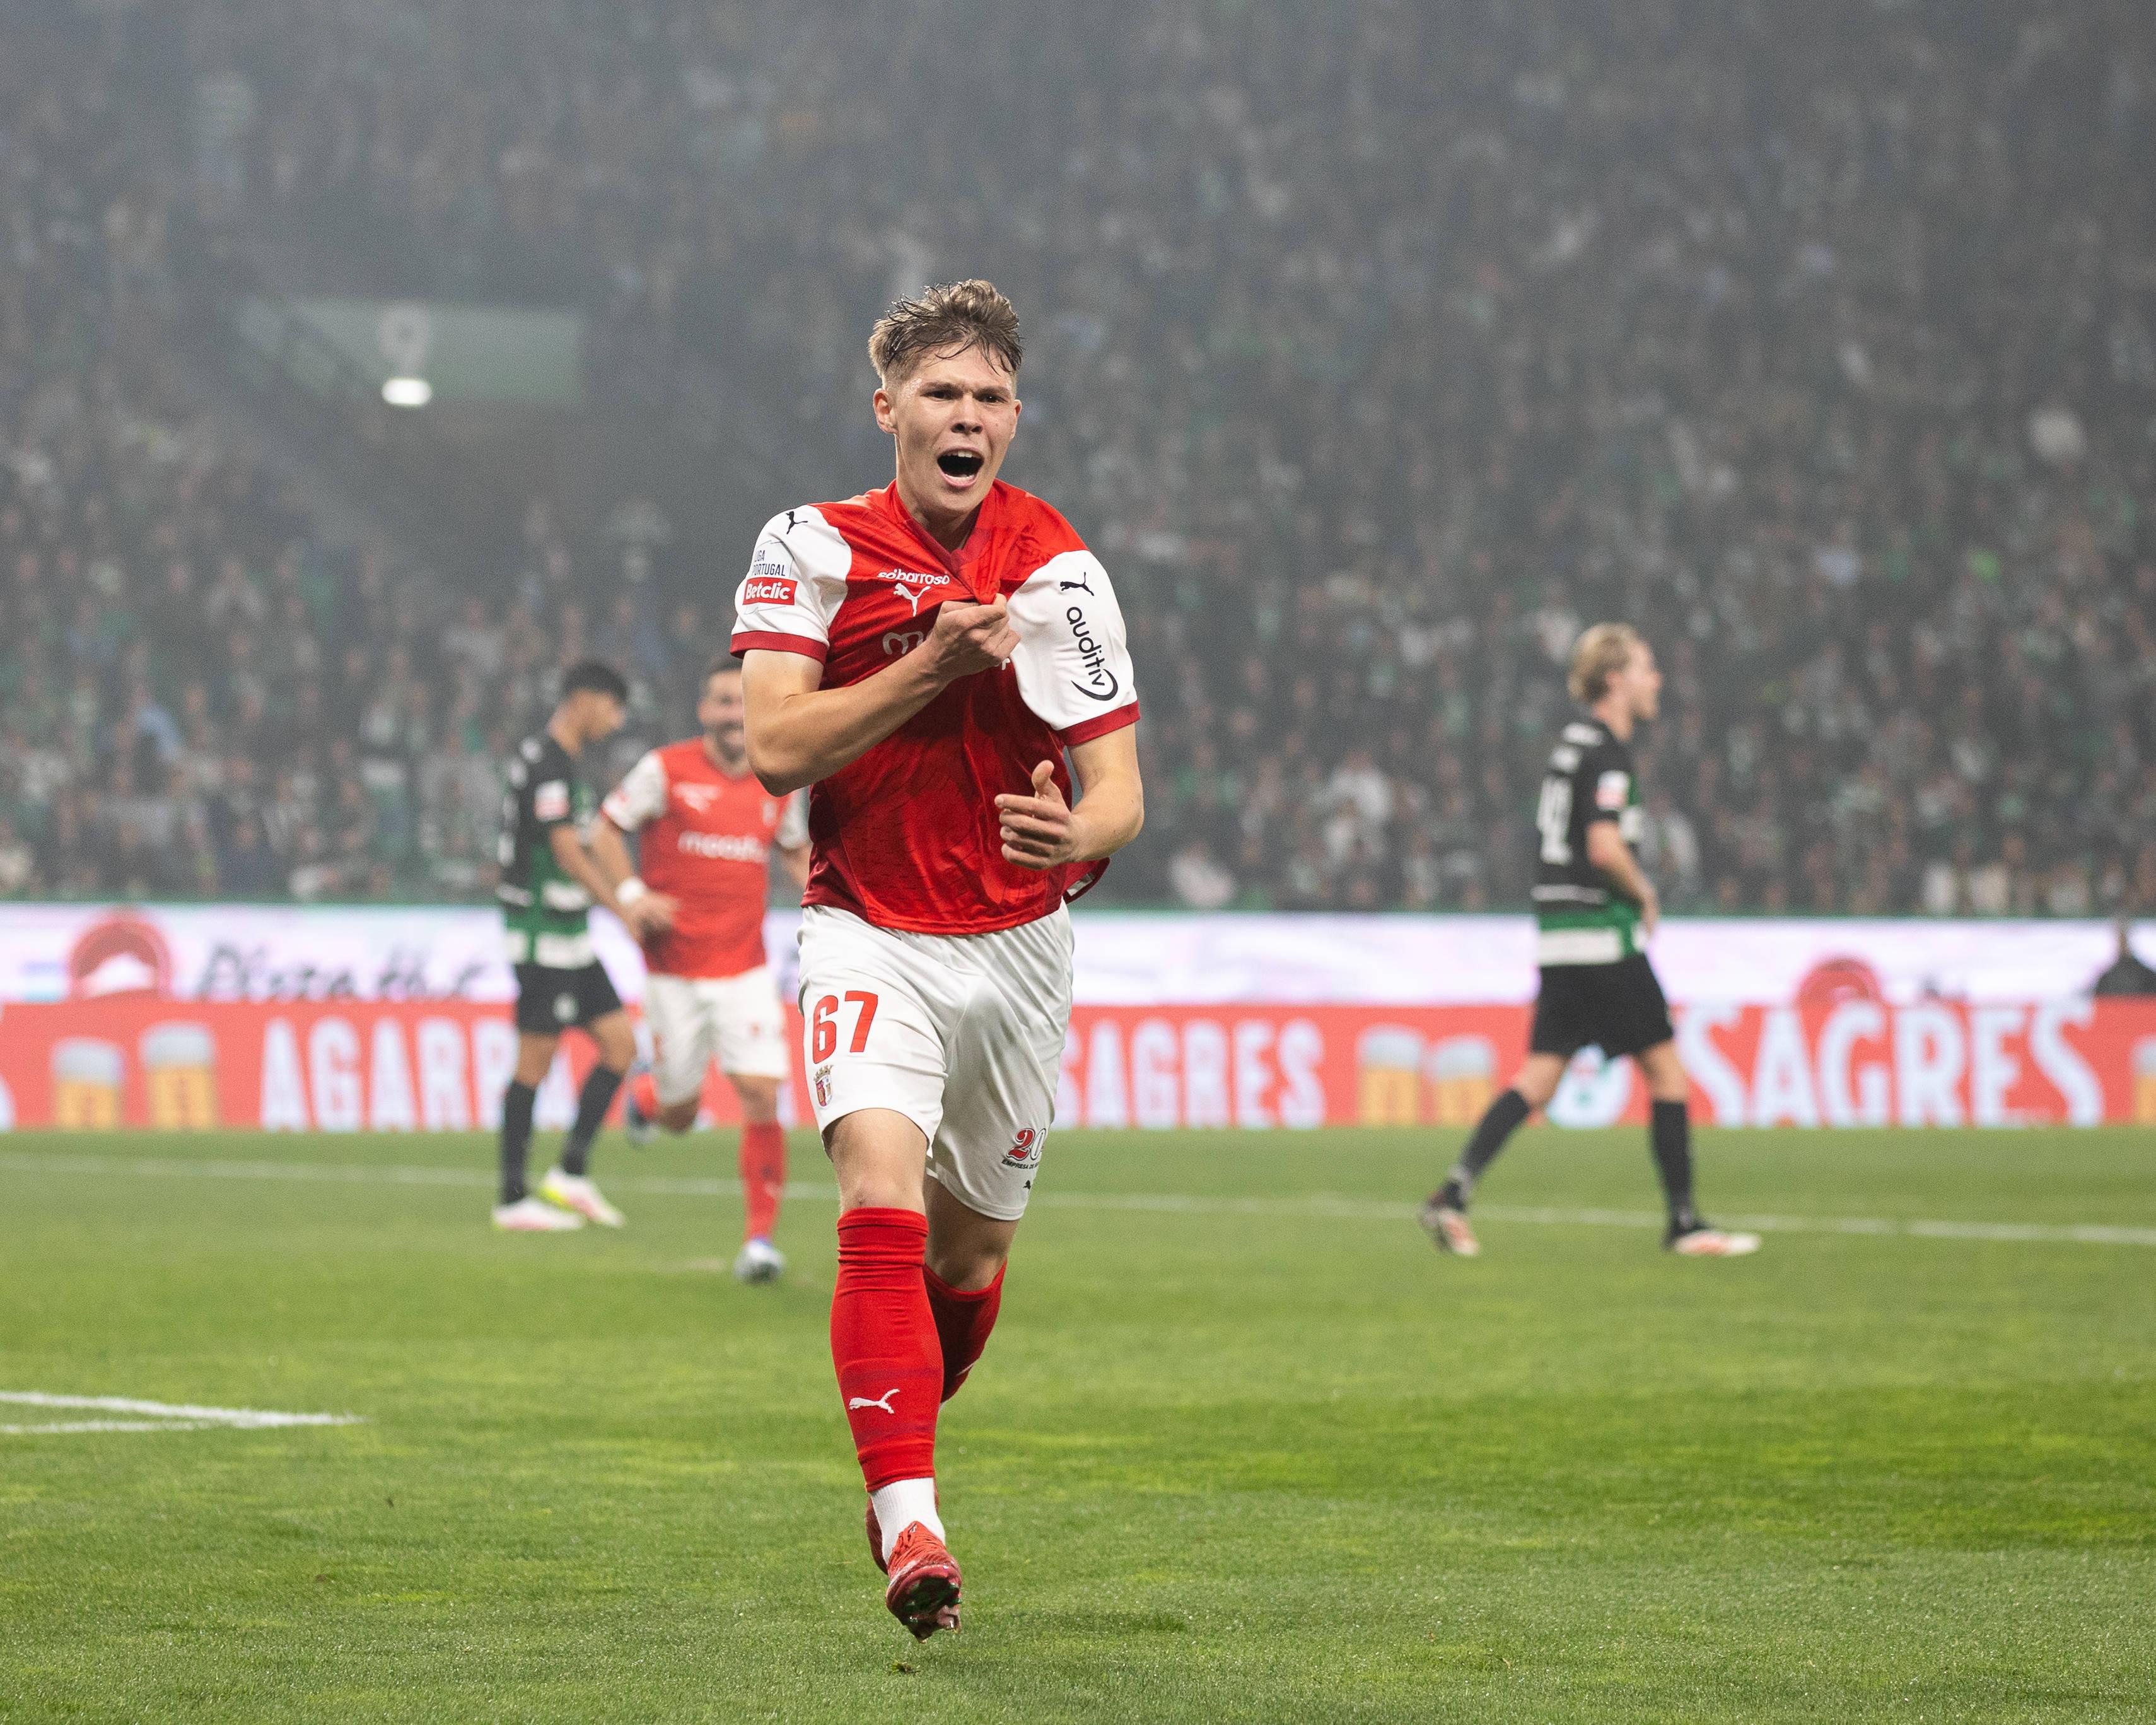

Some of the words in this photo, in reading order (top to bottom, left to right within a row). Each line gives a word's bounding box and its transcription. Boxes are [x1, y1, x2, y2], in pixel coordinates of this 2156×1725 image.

[745, 581, 791, 600] Betclic
[813, 990, 878, 1064] 67
[1677, 1004, 2106, 1129] SAGRES
